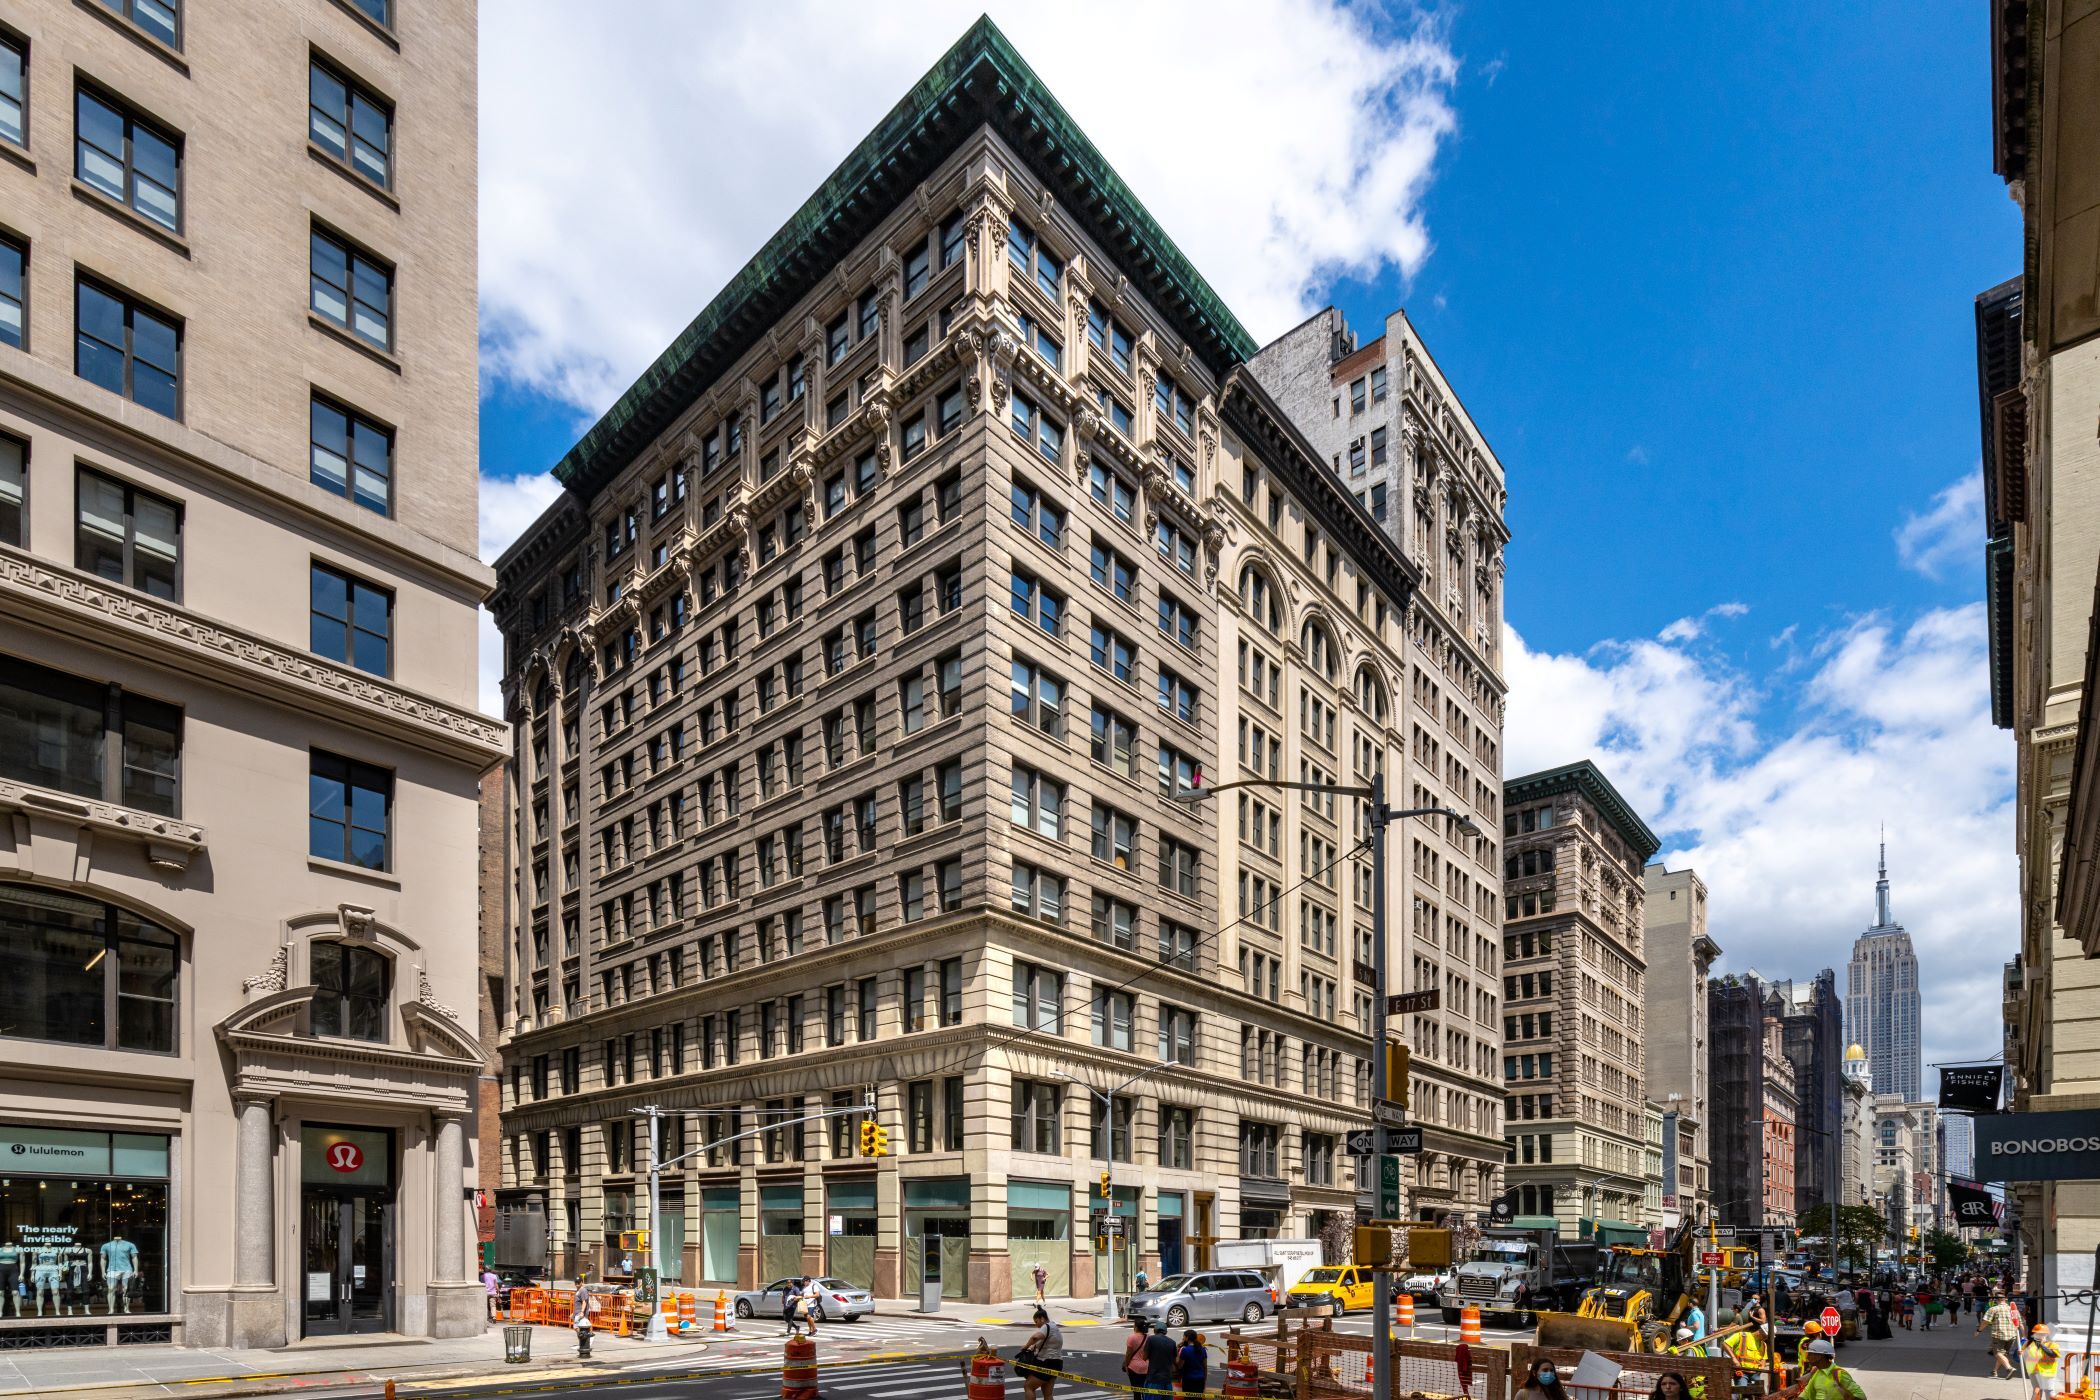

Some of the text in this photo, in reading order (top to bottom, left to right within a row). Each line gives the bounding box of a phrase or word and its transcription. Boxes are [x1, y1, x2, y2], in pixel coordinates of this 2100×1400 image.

[1395, 995, 1432, 1013] E 17 St
[1951, 1079, 1989, 1087] FISHER
[1376, 1105, 1403, 1121] ONE WAY
[1357, 1135, 1416, 1147] ON WAY
[1991, 1136, 2100, 1155] BONOBOS
[29, 1146, 84, 1157] lululemon
[17, 1225, 78, 1235] The nearly
[23, 1235, 72, 1243] invisible
[1821, 1315, 1839, 1327] STOP
